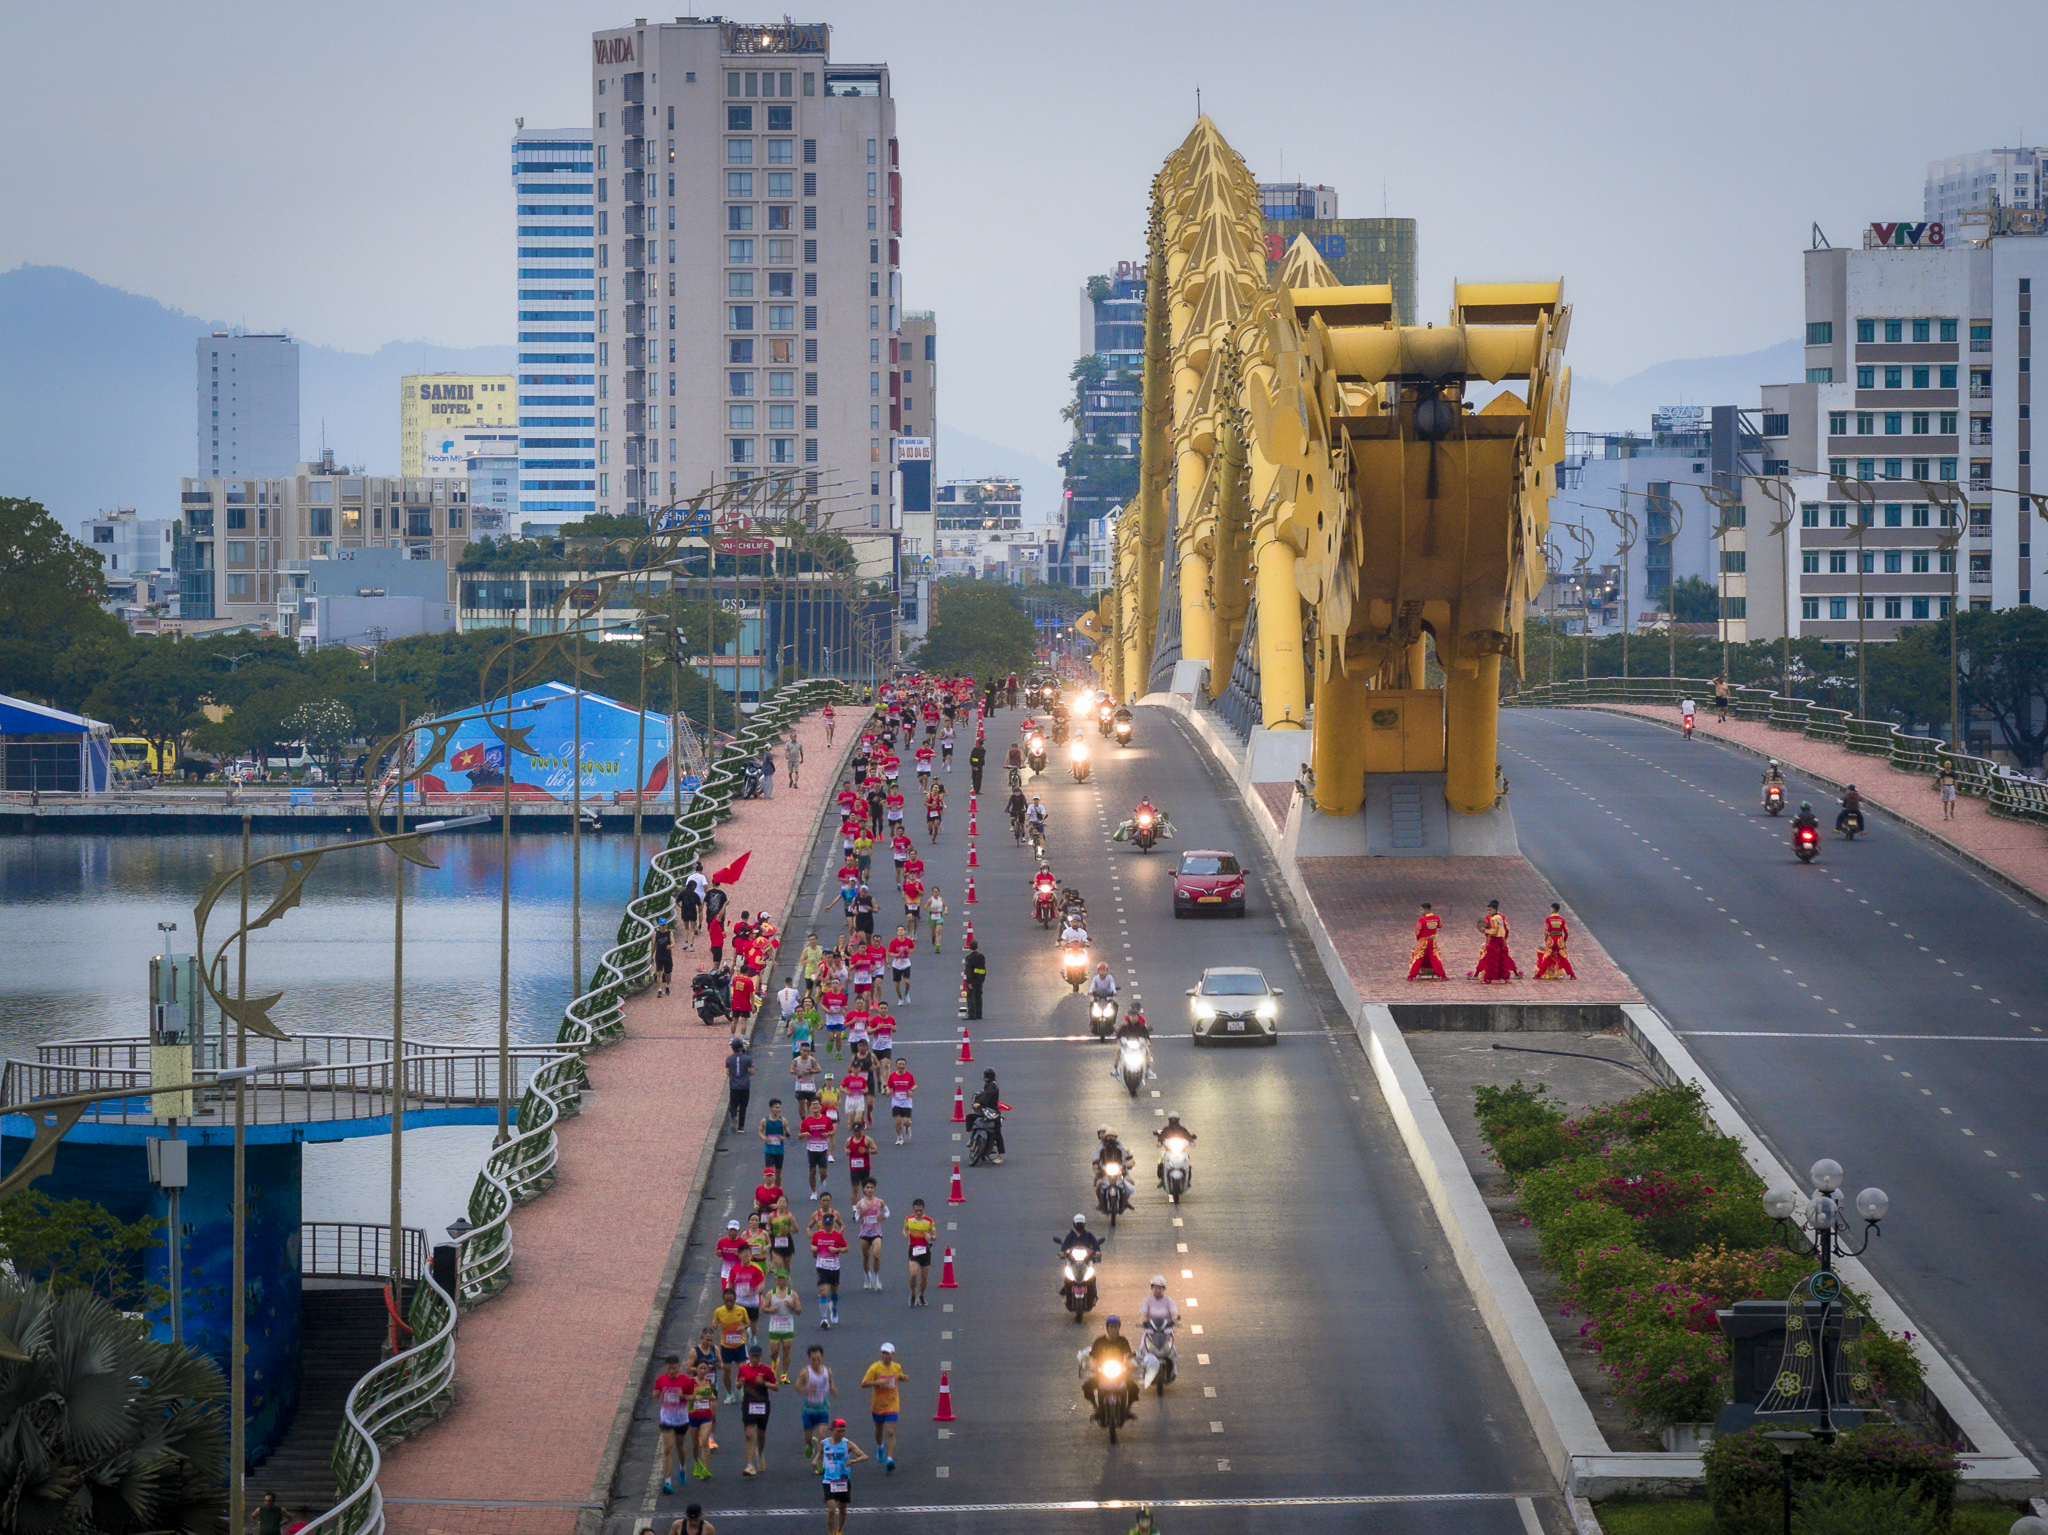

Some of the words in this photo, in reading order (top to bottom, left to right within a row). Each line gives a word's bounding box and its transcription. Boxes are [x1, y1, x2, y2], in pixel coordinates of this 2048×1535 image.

[719, 24, 823, 51] VANDA
[593, 36, 635, 64] VANDA
[420, 384, 474, 400] SAMDI
[431, 403, 471, 414] HOTEL
[906, 447, 913, 458] 03
[914, 447, 921, 458] 04
[922, 447, 930, 458] 05
